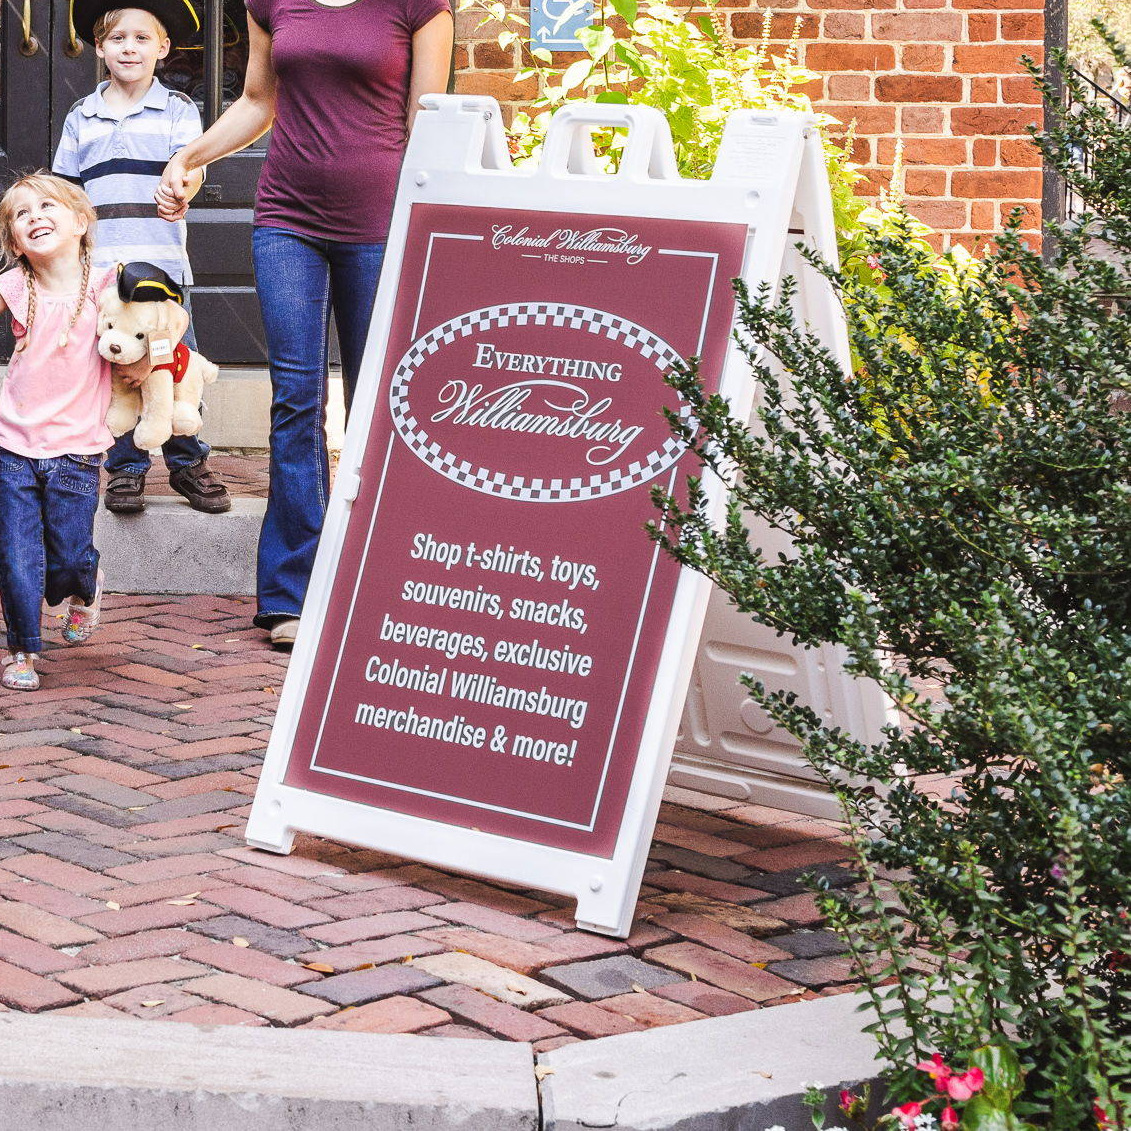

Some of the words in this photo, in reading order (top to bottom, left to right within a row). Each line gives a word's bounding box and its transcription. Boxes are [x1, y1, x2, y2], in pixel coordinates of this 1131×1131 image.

[491, 224, 561, 250] Colonial
[556, 227, 652, 265] Williamsburg
[543, 253, 559, 263] THE
[559, 255, 586, 265] SHOPS
[472, 343, 623, 382] EVERYTHING
[431, 379, 645, 466] Williamsburg
[410, 532, 462, 570] Shop
[466, 542, 545, 582] t-shirts,
[550, 555, 600, 591] toys,
[401, 579, 505, 620] souvenirs,
[509, 596, 589, 635] snacks,
[379, 614, 489, 663] beverages,
[493, 639, 593, 677] exclusive
[364, 655, 448, 696] Colonial
[450, 670, 588, 729] Williamsburg
[354, 702, 486, 748] merchandise
[490, 725, 506, 754] &
[512, 734, 579, 767] more!
